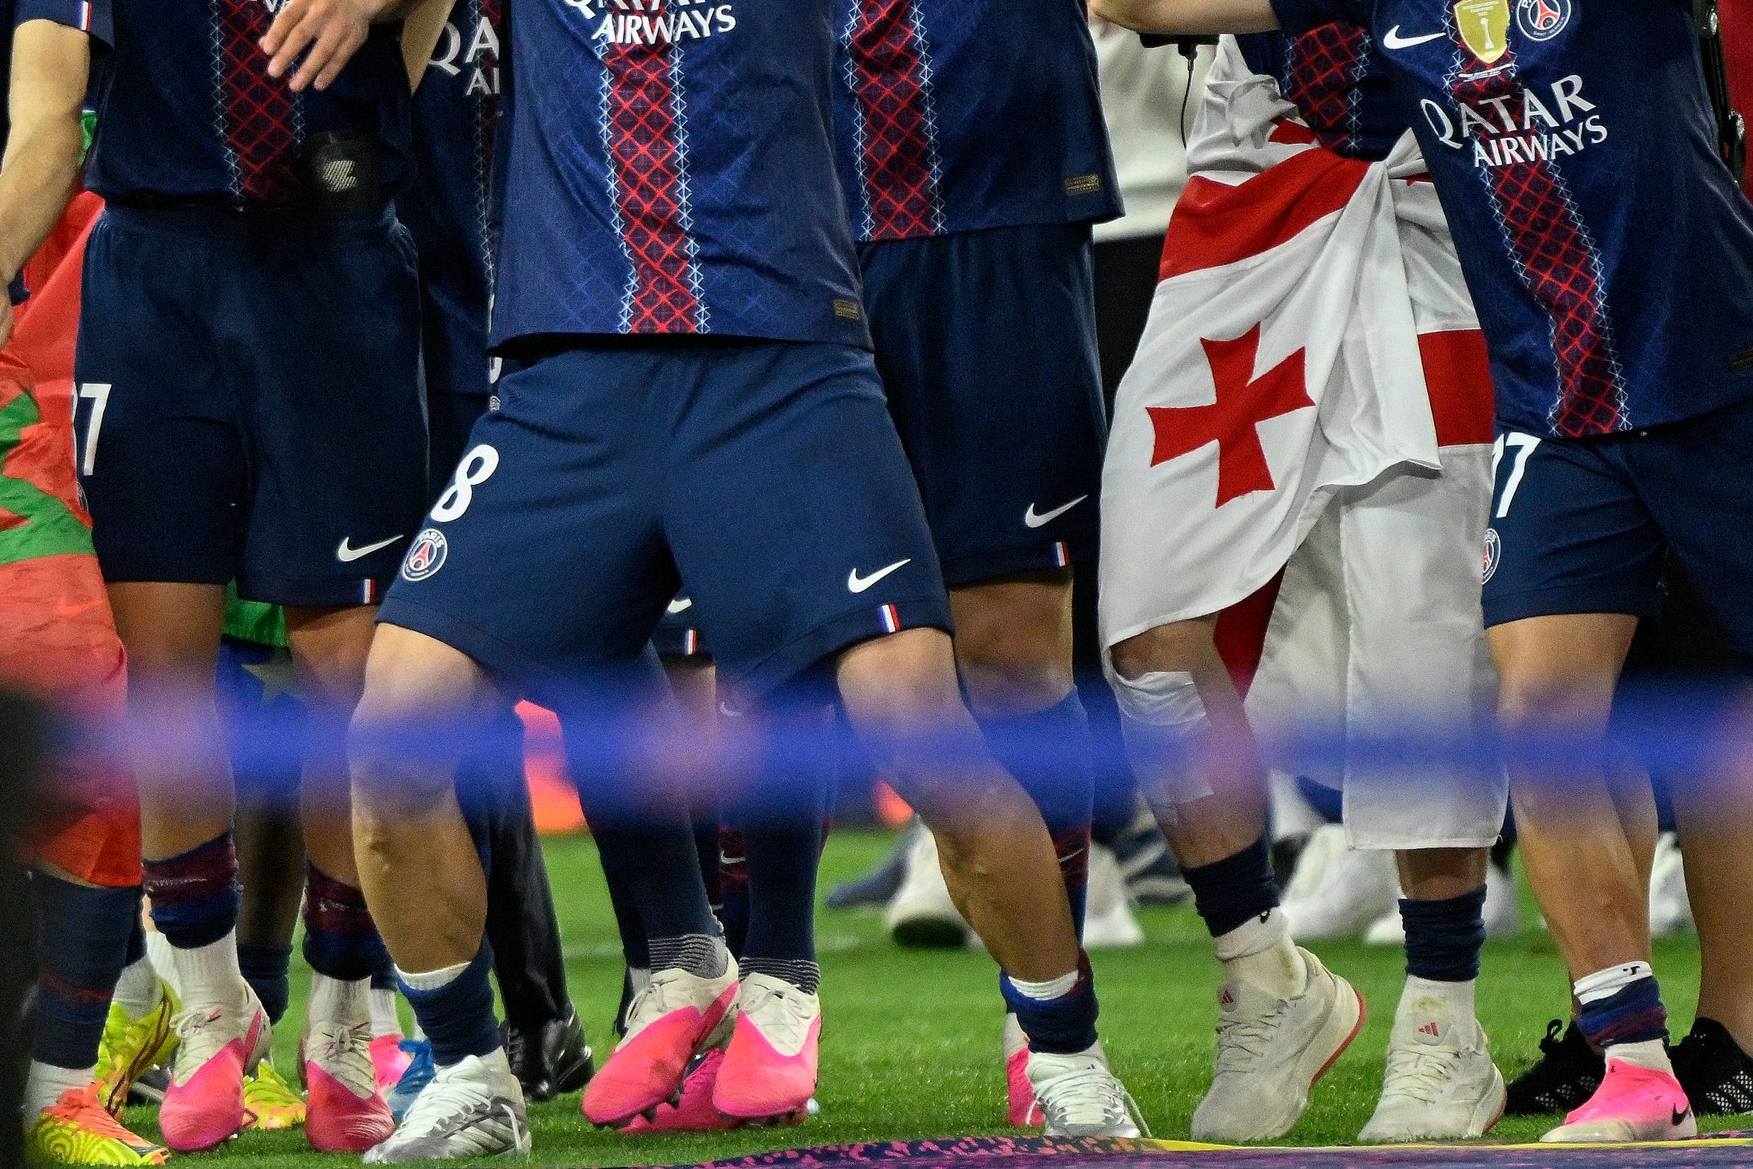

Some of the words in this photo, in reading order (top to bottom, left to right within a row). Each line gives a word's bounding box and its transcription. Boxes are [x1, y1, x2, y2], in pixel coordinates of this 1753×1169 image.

[591, 4, 737, 45] AIRWAYS
[1420, 74, 1597, 150] QATAR
[1474, 114, 1608, 168] AIRWAYS
[71, 381, 112, 477] 7
[430, 444, 499, 523] 8
